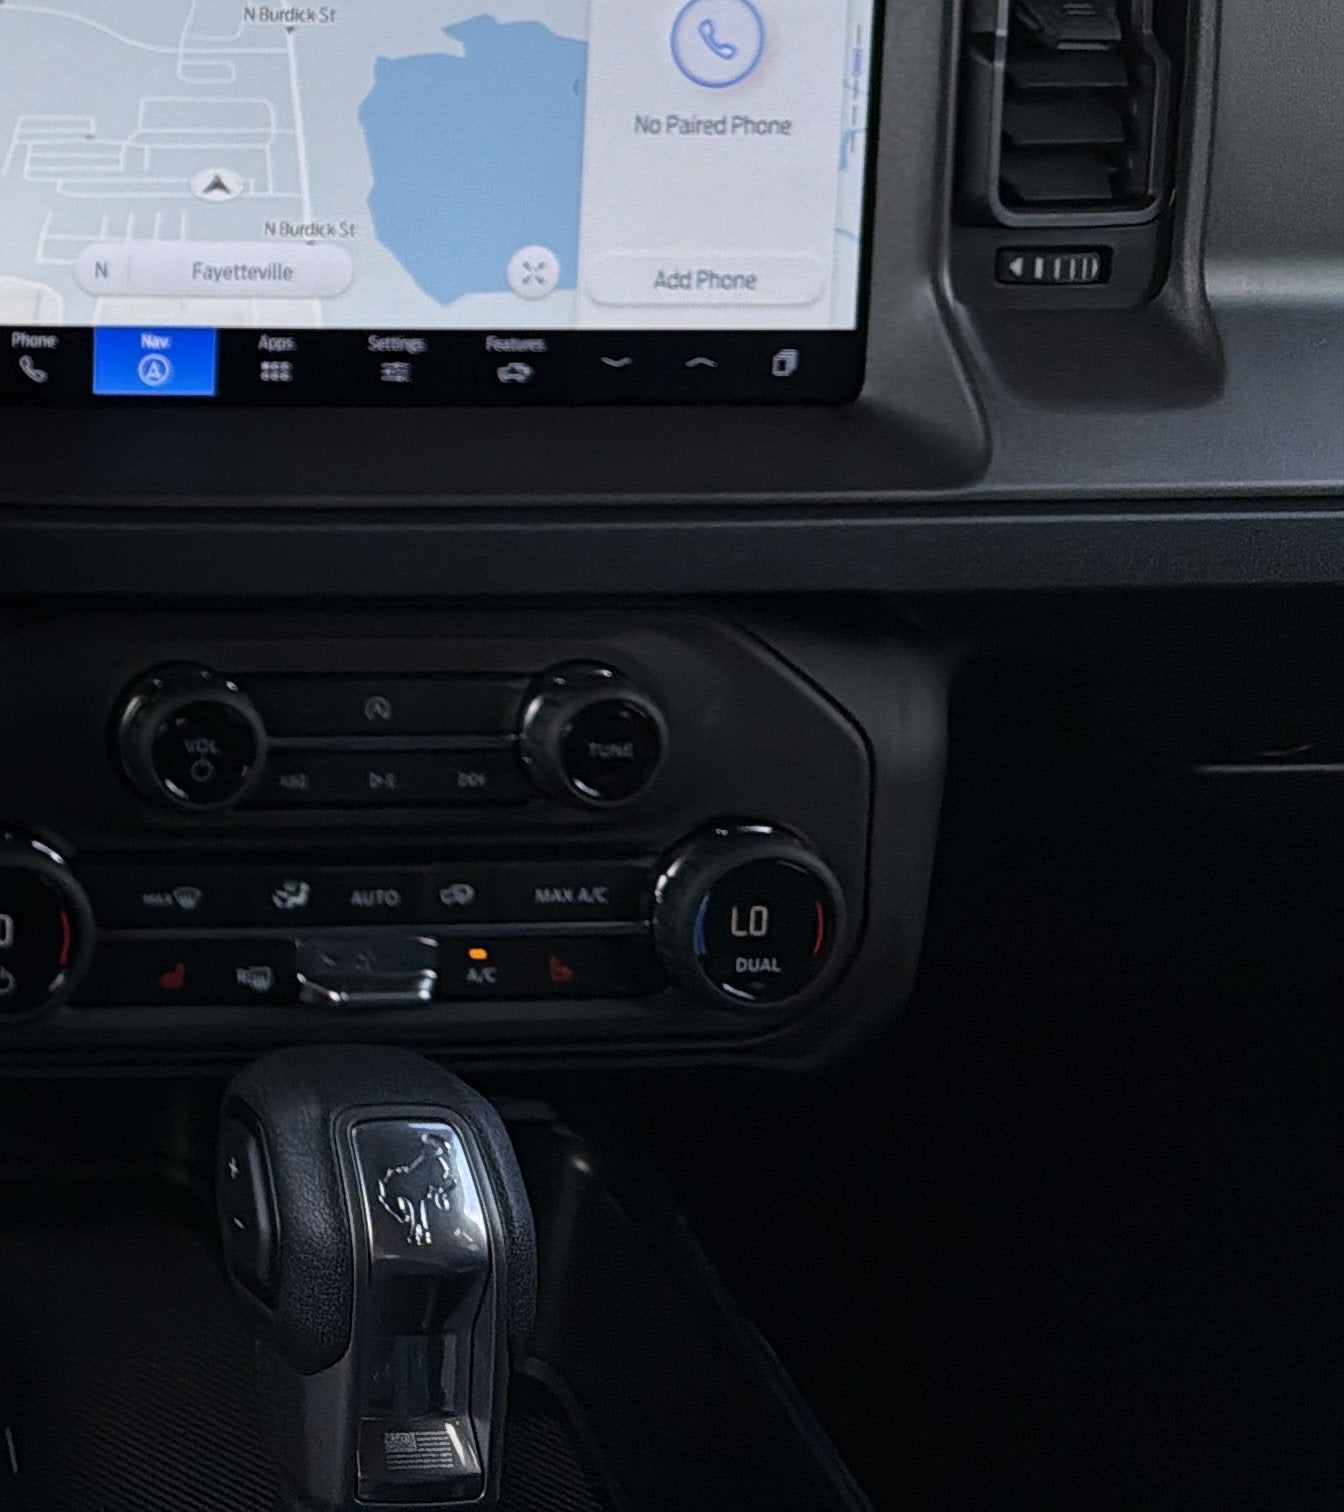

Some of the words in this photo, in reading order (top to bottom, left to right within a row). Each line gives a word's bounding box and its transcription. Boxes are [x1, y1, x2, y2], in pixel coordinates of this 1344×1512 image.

[243, 7, 256, 21] N
[259, 6, 315, 22] Burdick
[319, 7, 336, 23] St
[634, 115, 661, 135] No
[666, 114, 727, 136] Paired
[731, 115, 792, 136] Phone
[263, 222, 277, 235] N
[279, 221, 335, 237] Burdick
[339, 221, 356, 238] St
[95, 262, 108, 279] N
[192, 261, 294, 283] Fayetteville
[653, 270, 692, 289] Add
[695, 269, 758, 290] Phone
[11, 332, 60, 349] Phone
[140, 333, 171, 350] Nav
[258, 334, 297, 353] Apps
[367, 334, 429, 355] Settings
[350, 889, 402, 907] AUTO
[534, 888, 574, 903] MAX
[577, 886, 609, 904] A/C
[735, 956, 782, 973] DUAL
[466, 966, 498, 984] A/C
